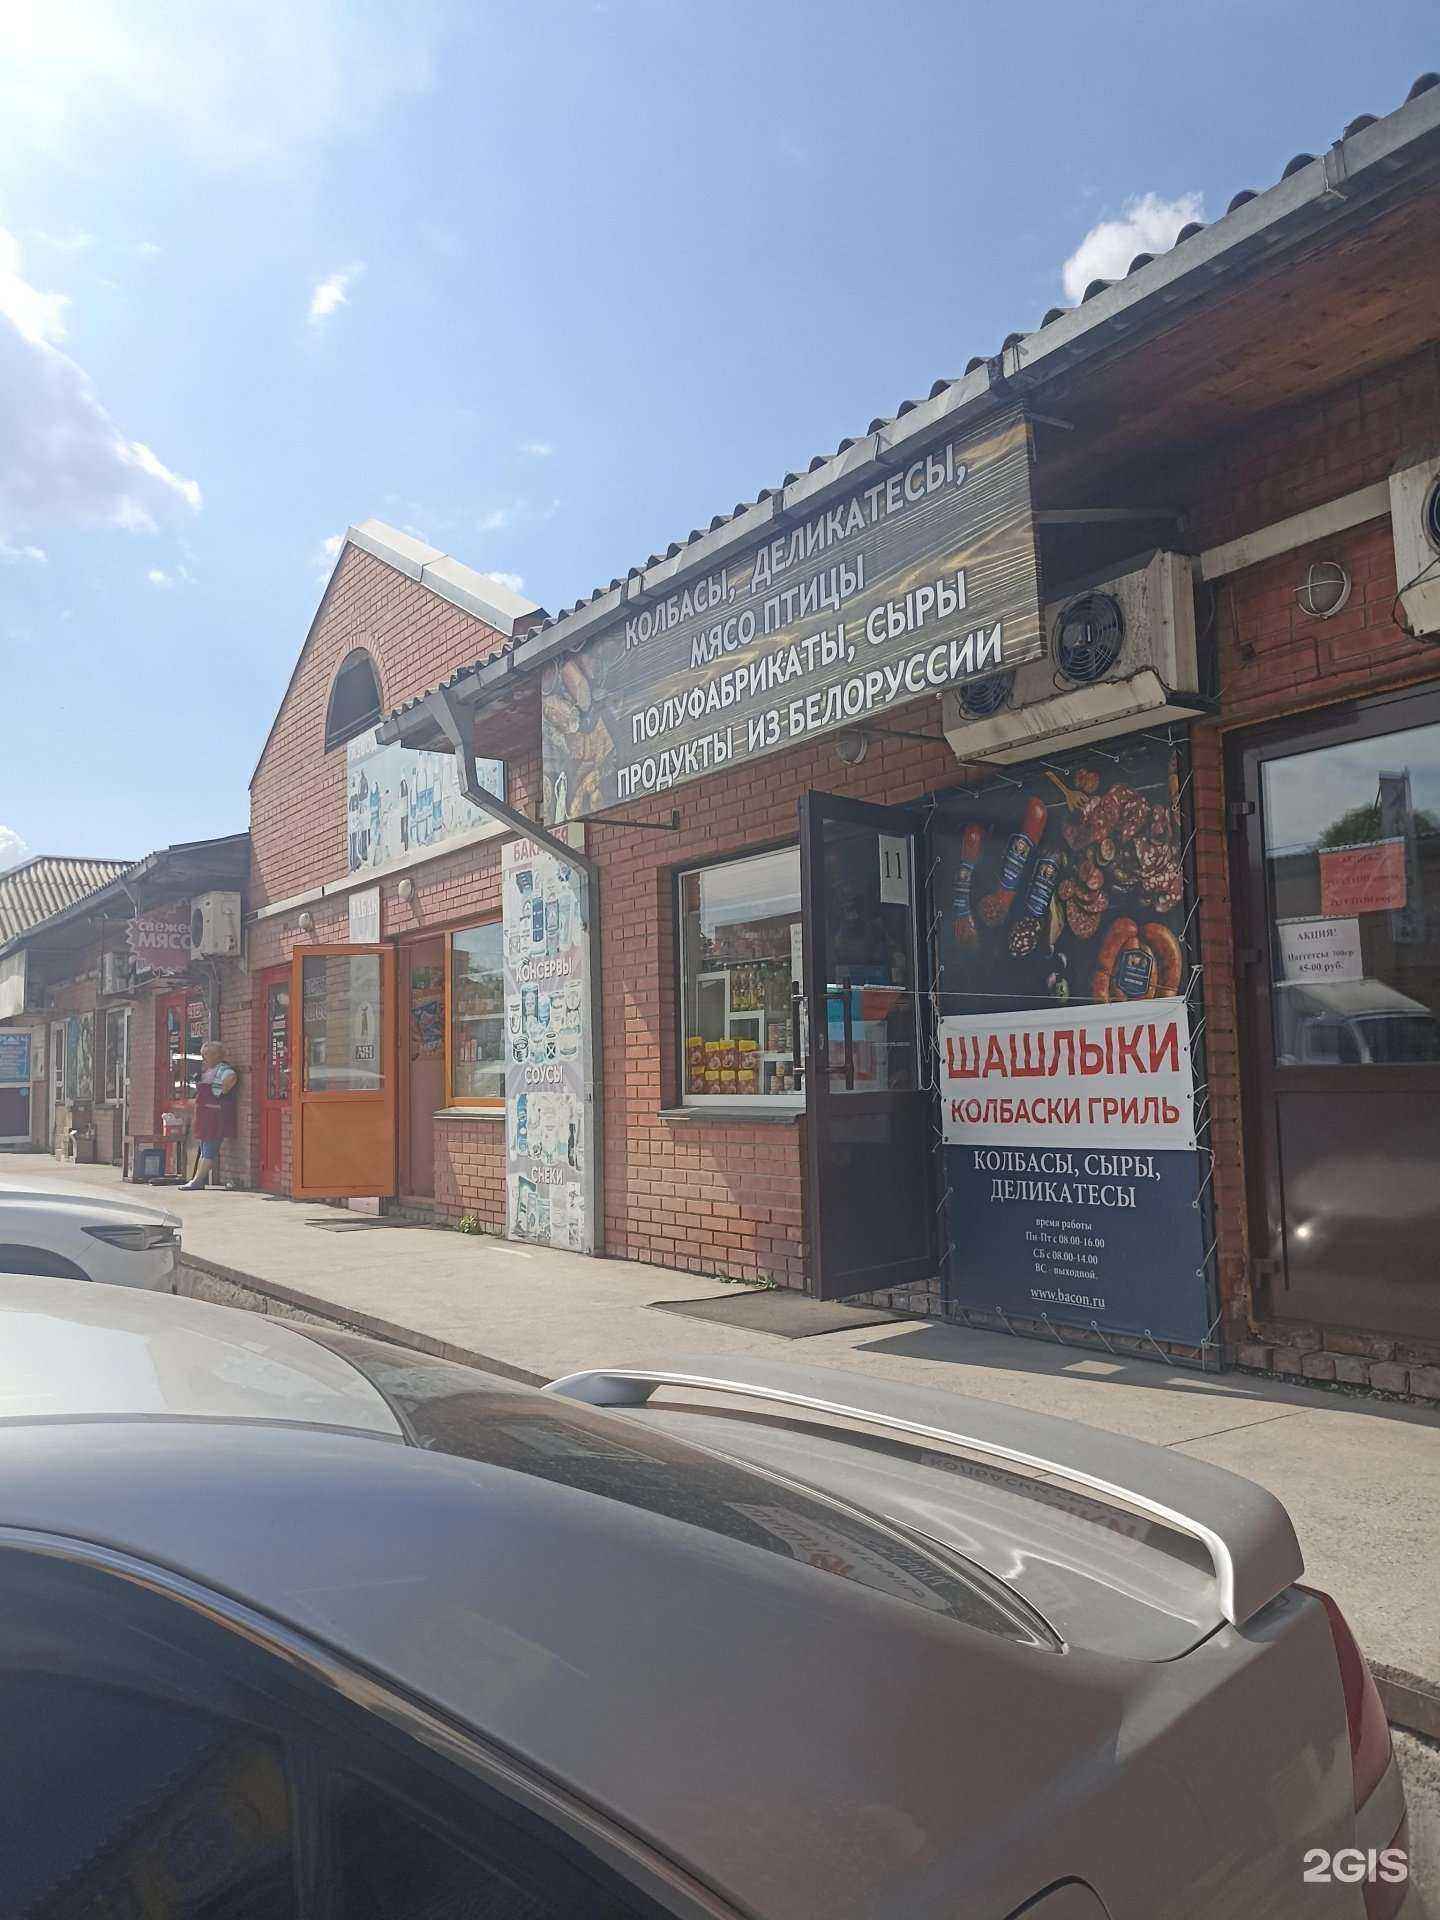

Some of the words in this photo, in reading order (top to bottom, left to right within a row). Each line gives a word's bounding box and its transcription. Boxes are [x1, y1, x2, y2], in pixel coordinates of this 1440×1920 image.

[624, 568, 736, 650] КОЛБАСЫ,
[750, 445, 967, 591] ДЕЛИКАТЕСЫ,
[689, 612, 756, 670] МЯСО
[763, 554, 867, 634] ПТИЦЫ
[631, 624, 856, 744] ПОЛУФАБРИКАТЫ,
[865, 570, 967, 646] СЫРЫ
[616, 729, 734, 799] ПРОДУКТЫ
[747, 716, 780, 753] ИЗ
[788, 623, 1003, 734] БЕЛОРУССИИ
[884, 851, 903, 879] 11
[516, 957, 574, 983] КОНСЕРВЫ
[946, 1022, 1181, 1080] ШАШЛЫКИ
[525, 1065, 564, 1085] СОУСЫ
[951, 1097, 1081, 1125] КОЛБАСКИ
[1087, 1096, 1180, 1125] ГРИЛЬ
[531, 1167, 563, 1185] СНЕКИ
[973, 1150, 1080, 1178] КОЛБАСЫ,
[1084, 1153, 1162, 1181] СЫРЫ,
[990, 1179, 1137, 1209] ДЕЛИКАТЕСЫ
[1035, 1218, 1060, 1229] время
[1061, 1220, 1092, 1231] работы
[1030, 1288, 1105, 1309] www.bacon.ru
